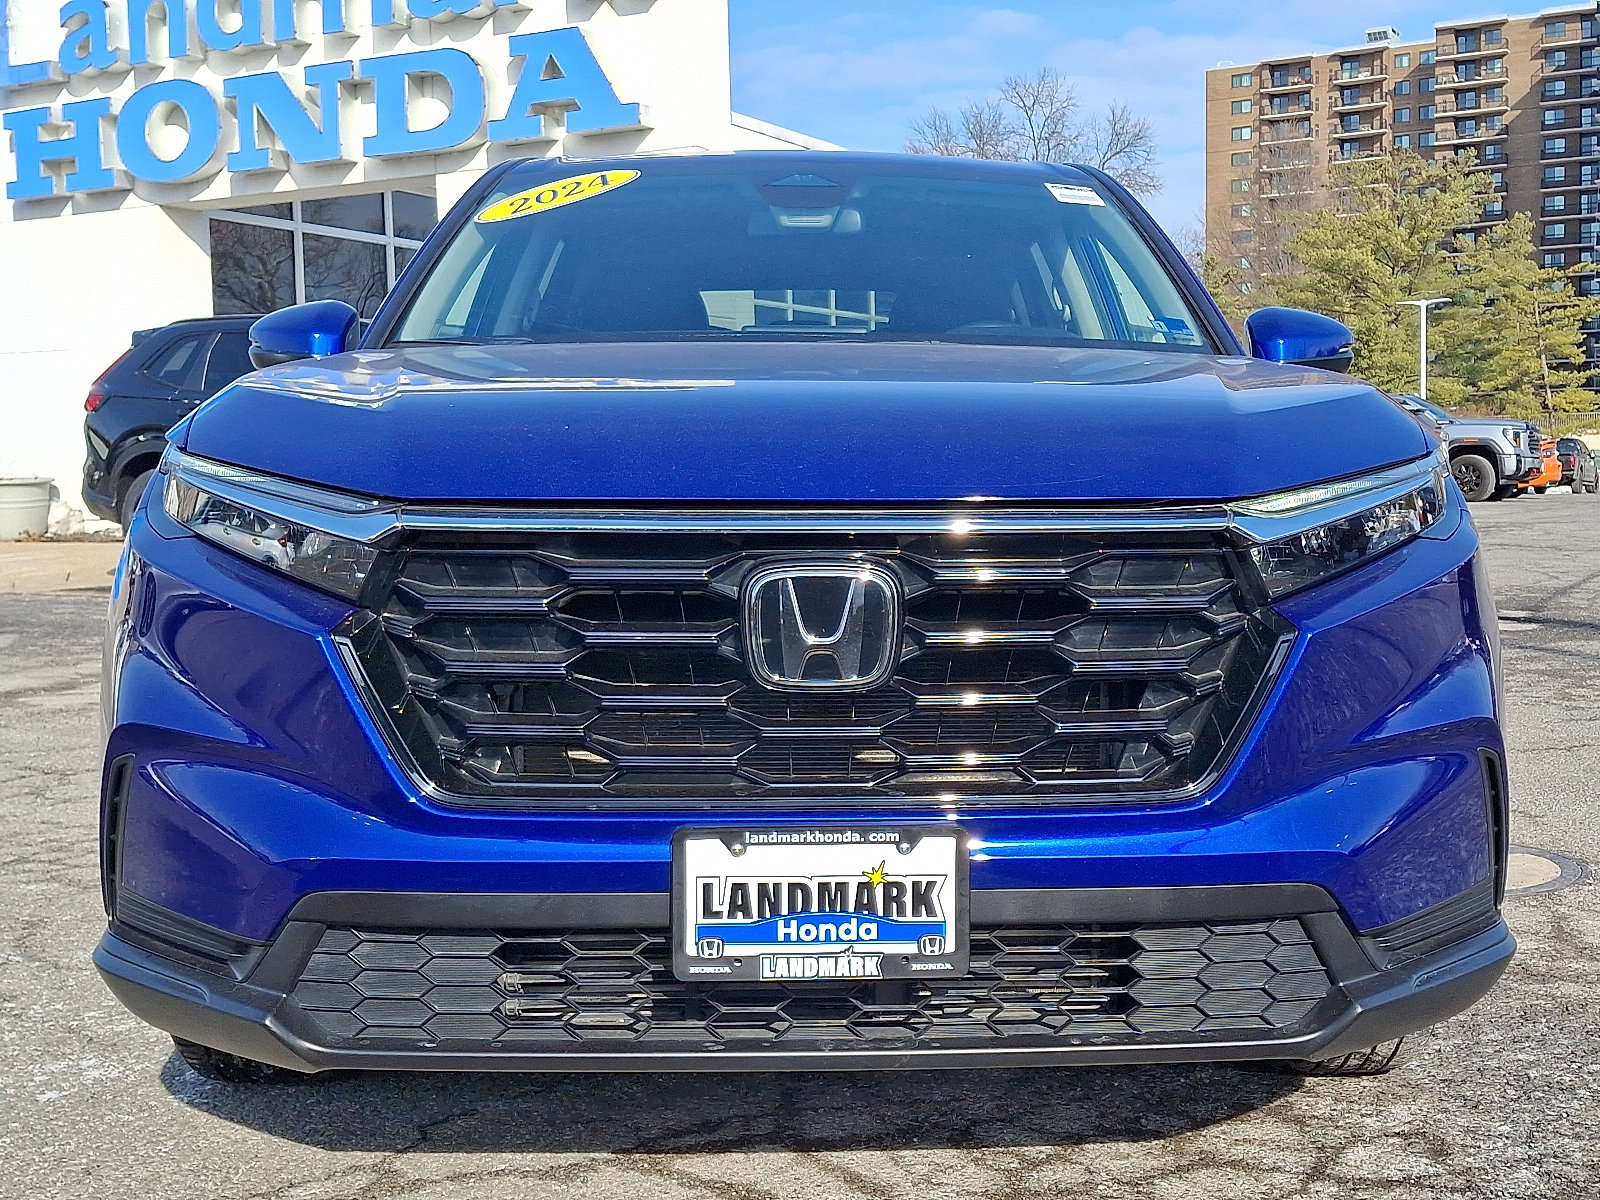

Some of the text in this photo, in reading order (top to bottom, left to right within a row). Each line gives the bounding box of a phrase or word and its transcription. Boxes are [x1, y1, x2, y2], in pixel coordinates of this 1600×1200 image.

[0, 0, 518, 87] Land
[3, 26, 640, 200] HONDA
[509, 174, 614, 215] 2024
[702, 880, 939, 920] LANDMARK
[776, 918, 879, 943] Honda
[761, 955, 880, 978] LANDMARK
[911, 962, 954, 971] HONDA
